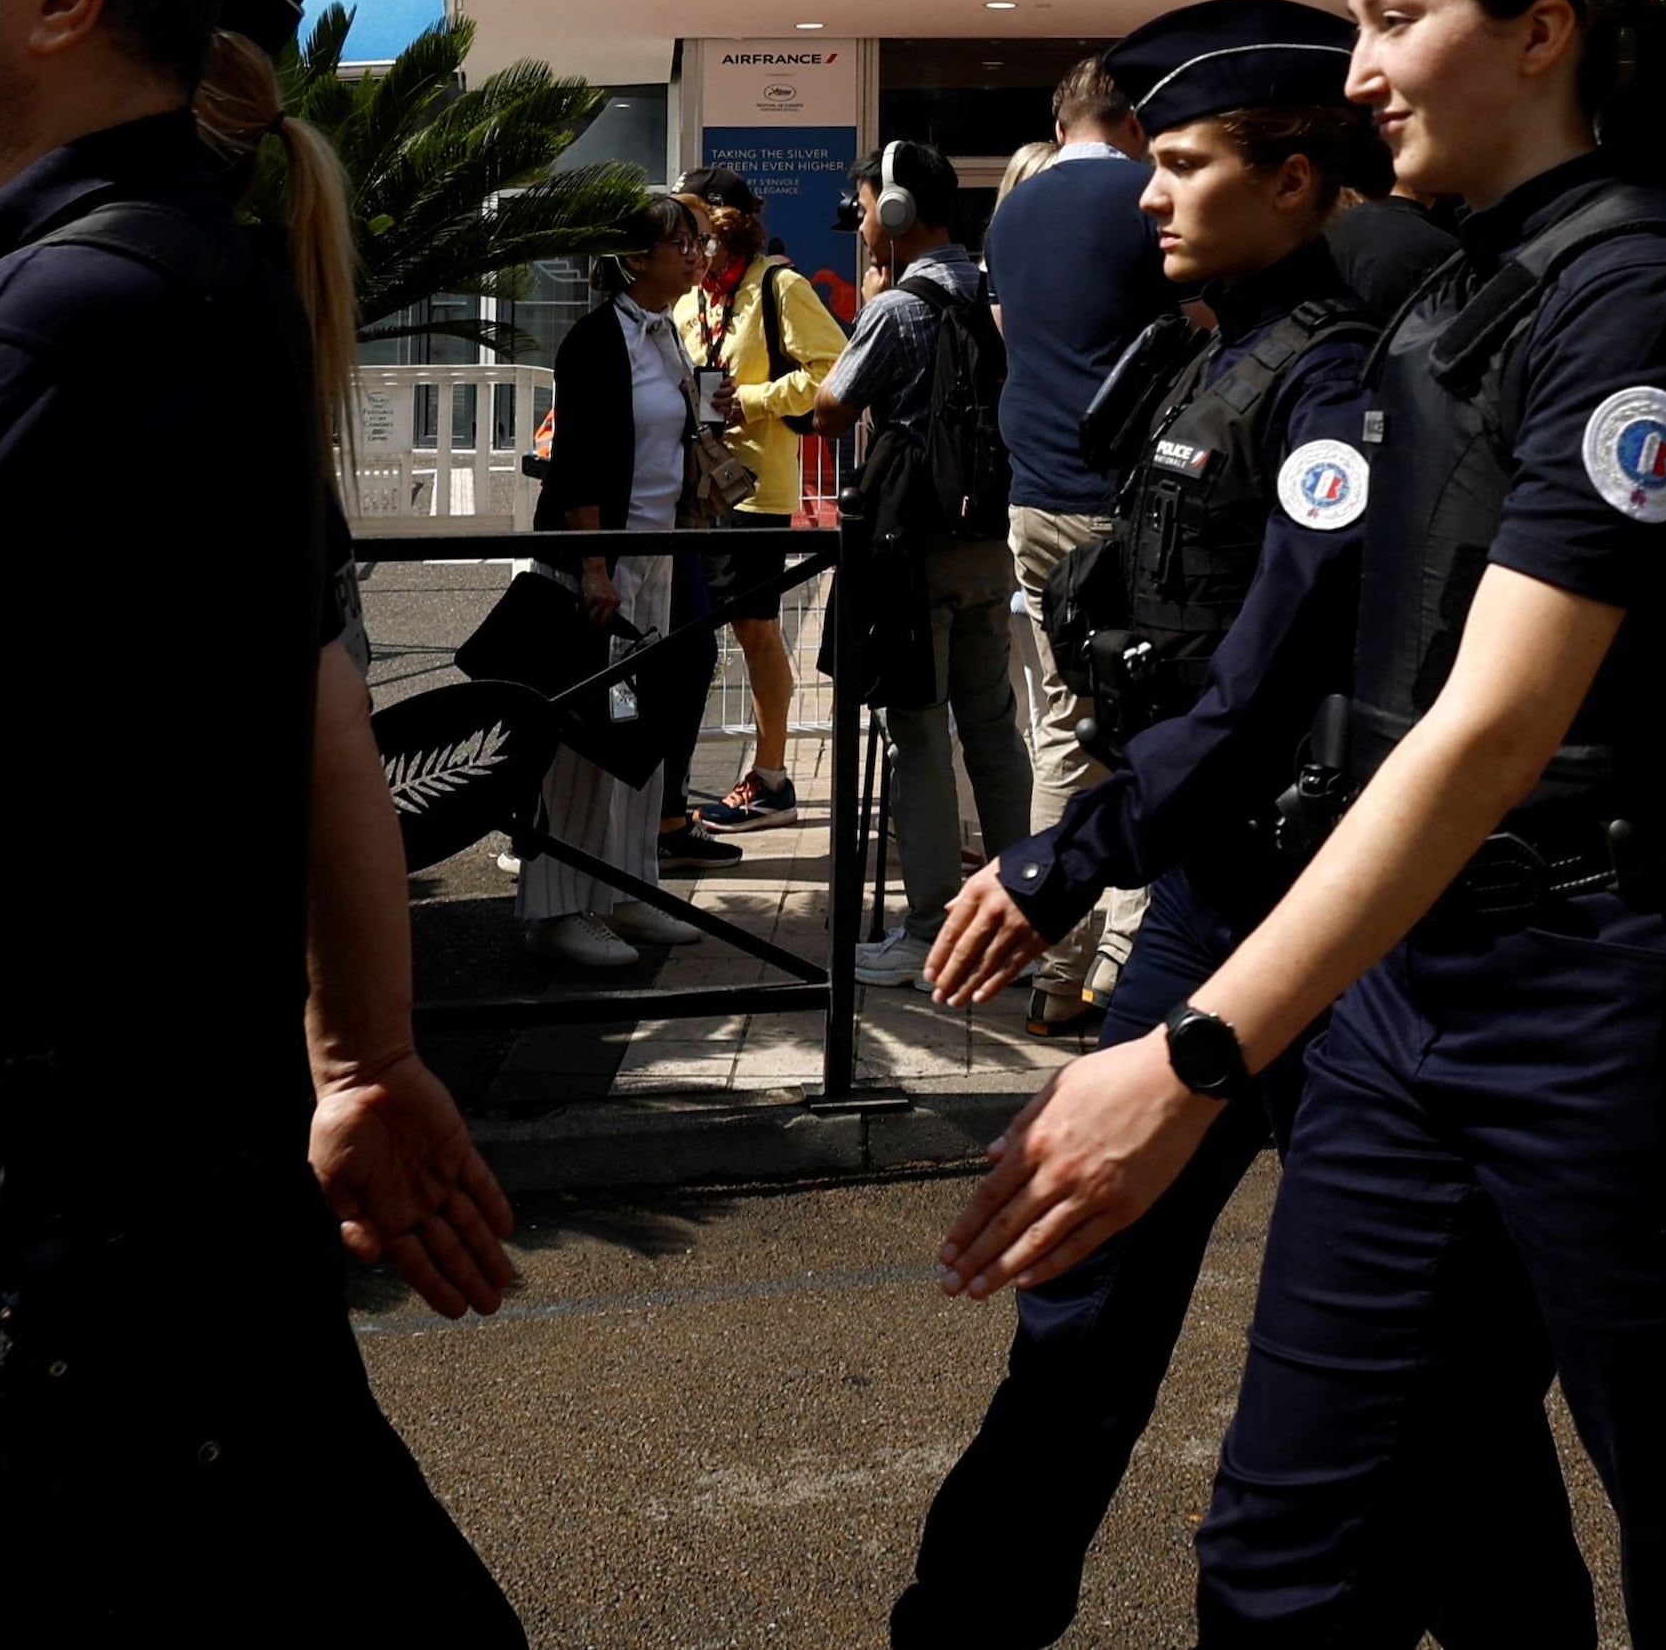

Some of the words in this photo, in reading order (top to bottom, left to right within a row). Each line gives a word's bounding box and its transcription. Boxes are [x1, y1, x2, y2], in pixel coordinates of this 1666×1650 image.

[722, 53, 822, 65] AIRFRANCE
[711, 149, 757, 159] TAKING
[761, 149, 784, 159] THE
[787, 149, 829, 159] SILVER
[762, 161, 794, 171] EVEN
[798, 161, 848, 171] HIGHER.
[1156, 440, 1194, 460] POLICE
